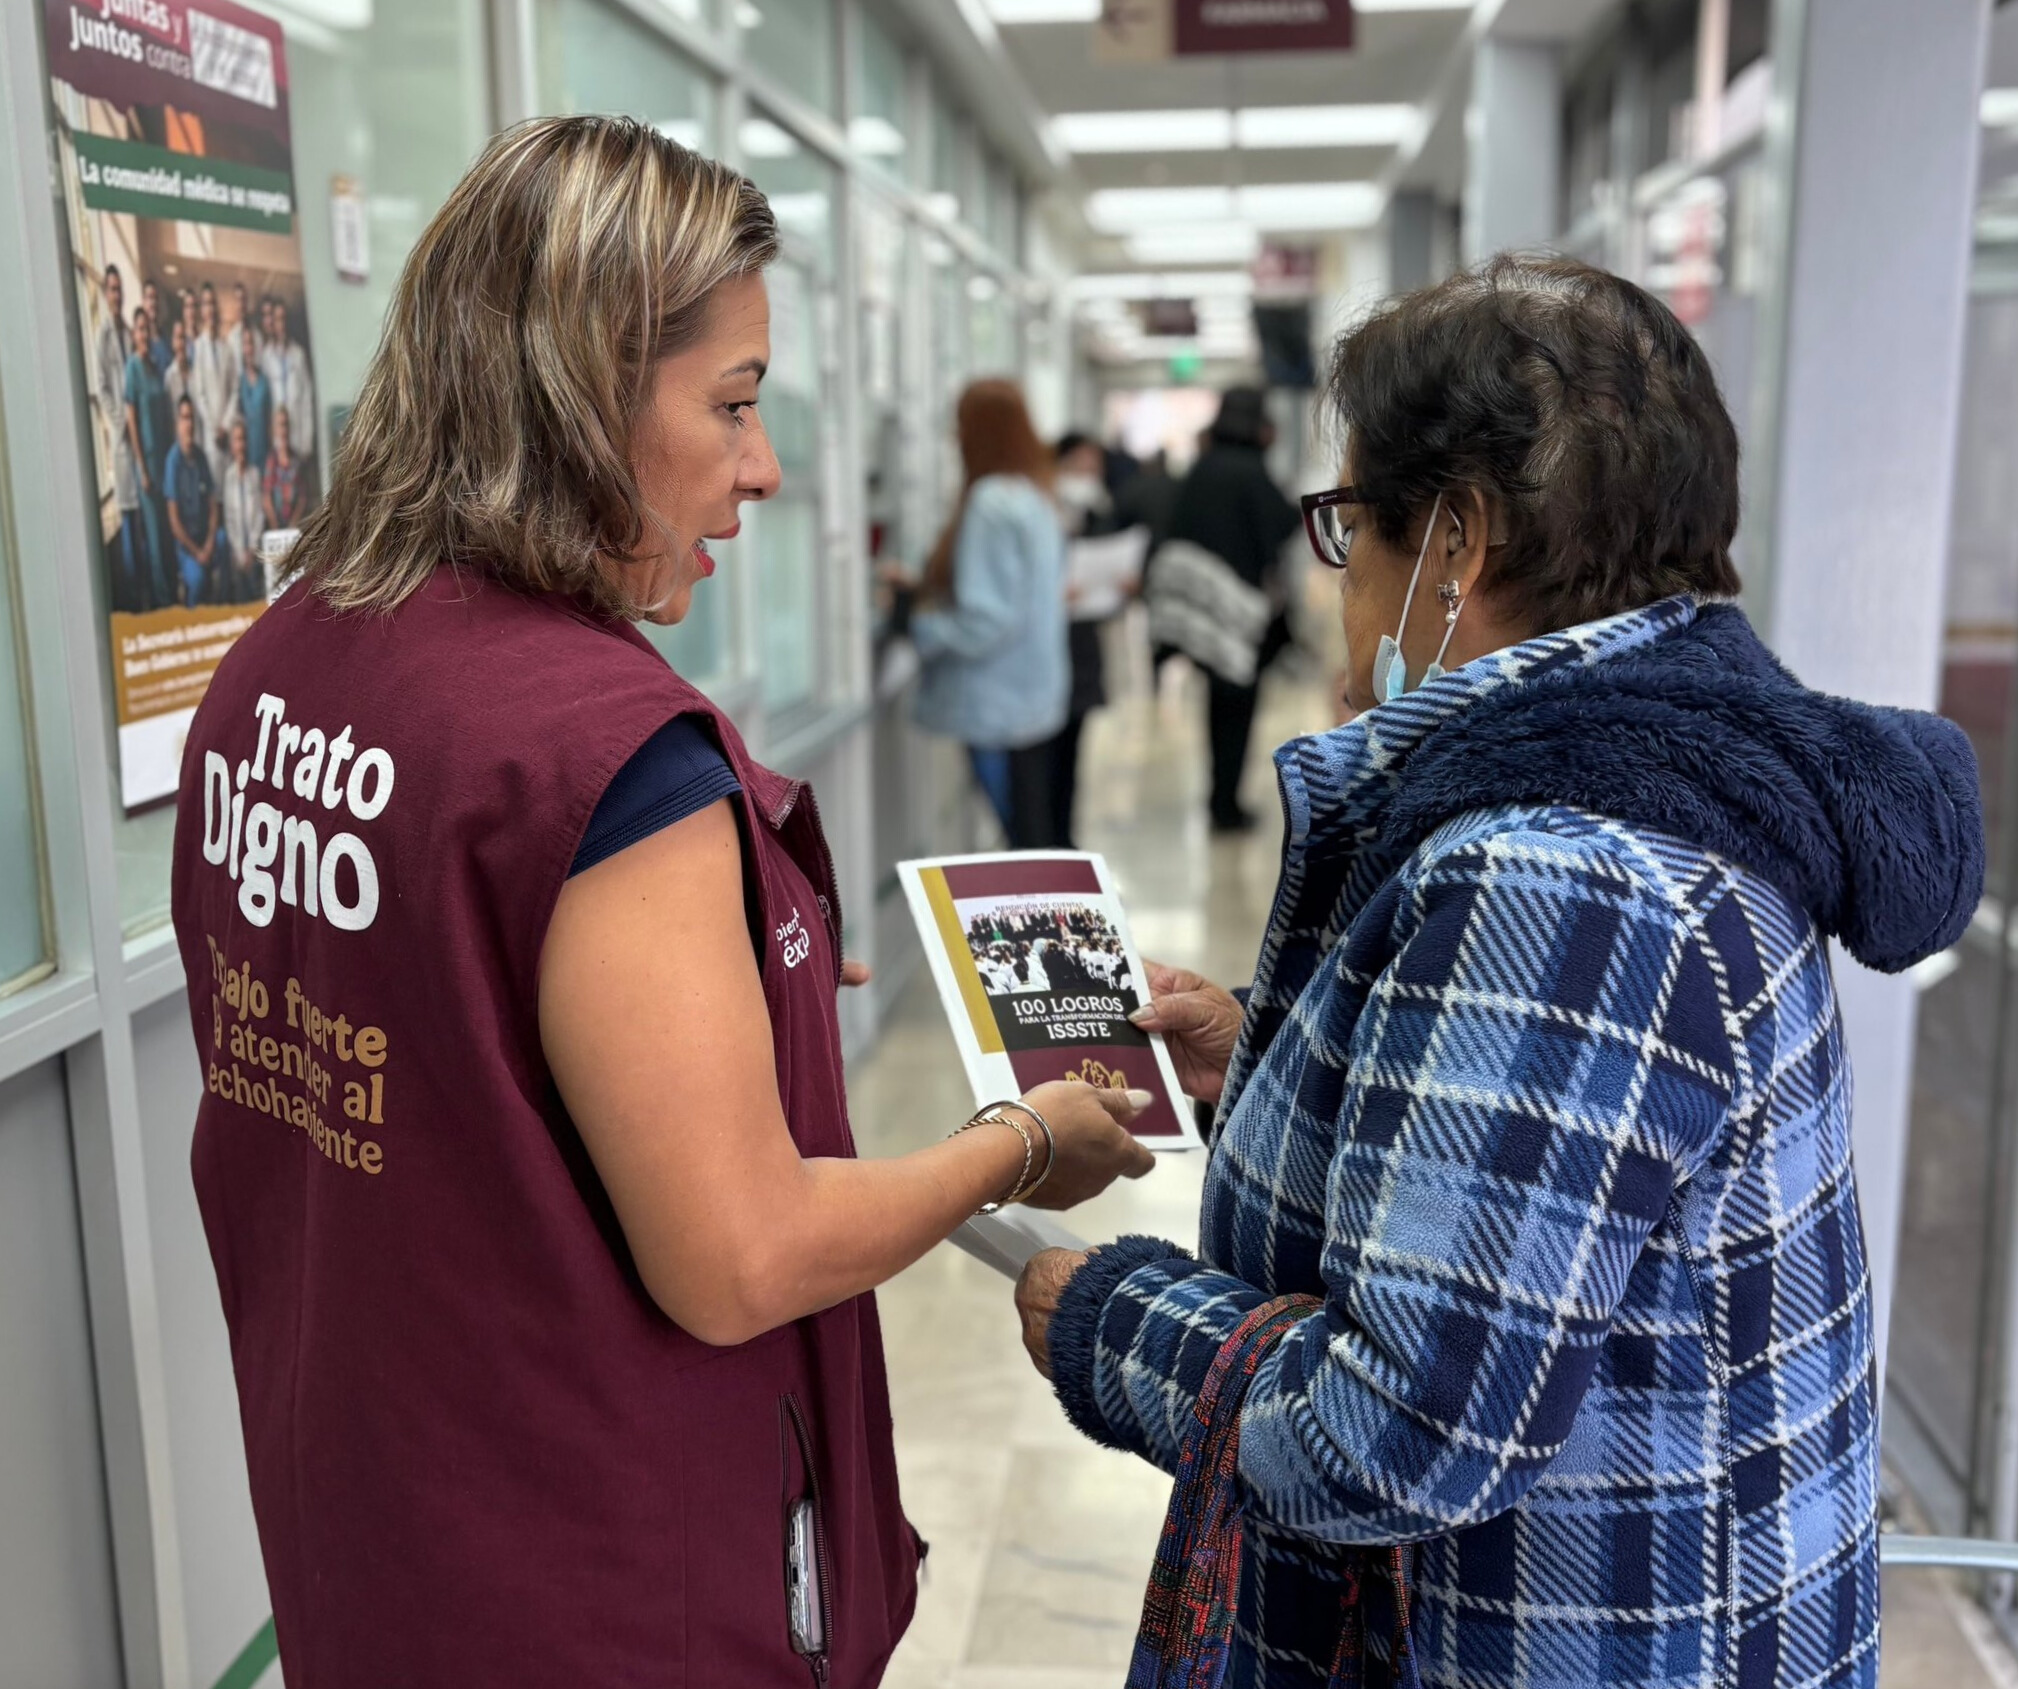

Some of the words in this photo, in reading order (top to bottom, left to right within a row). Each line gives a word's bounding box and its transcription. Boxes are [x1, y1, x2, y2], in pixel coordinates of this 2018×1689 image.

[69, 5, 144, 62] Juntos
[145, 44, 192, 79] contra
[172, 13, 183, 44] y
[78, 155, 100, 184] La
[102, 164, 182, 197] comunidad
[250, 692, 395, 821] Trato
[203, 750, 380, 931] Digno
[284, 977, 388, 1067] fuerte
[1012, 998, 1046, 1016] 100
[1050, 995, 1124, 1012] LOGROS
[1019, 1016, 1040, 1025] PARA
[1040, 1015, 1051, 1023] LA
[1051, 1012, 1114, 1022] TRANSFORMACIÓN
[1114, 1013, 1127, 1021] DEL
[1046, 1021, 1111, 1039] ISSSTE
[230, 1023, 332, 1106] atender
[343, 1073, 384, 1124] al
